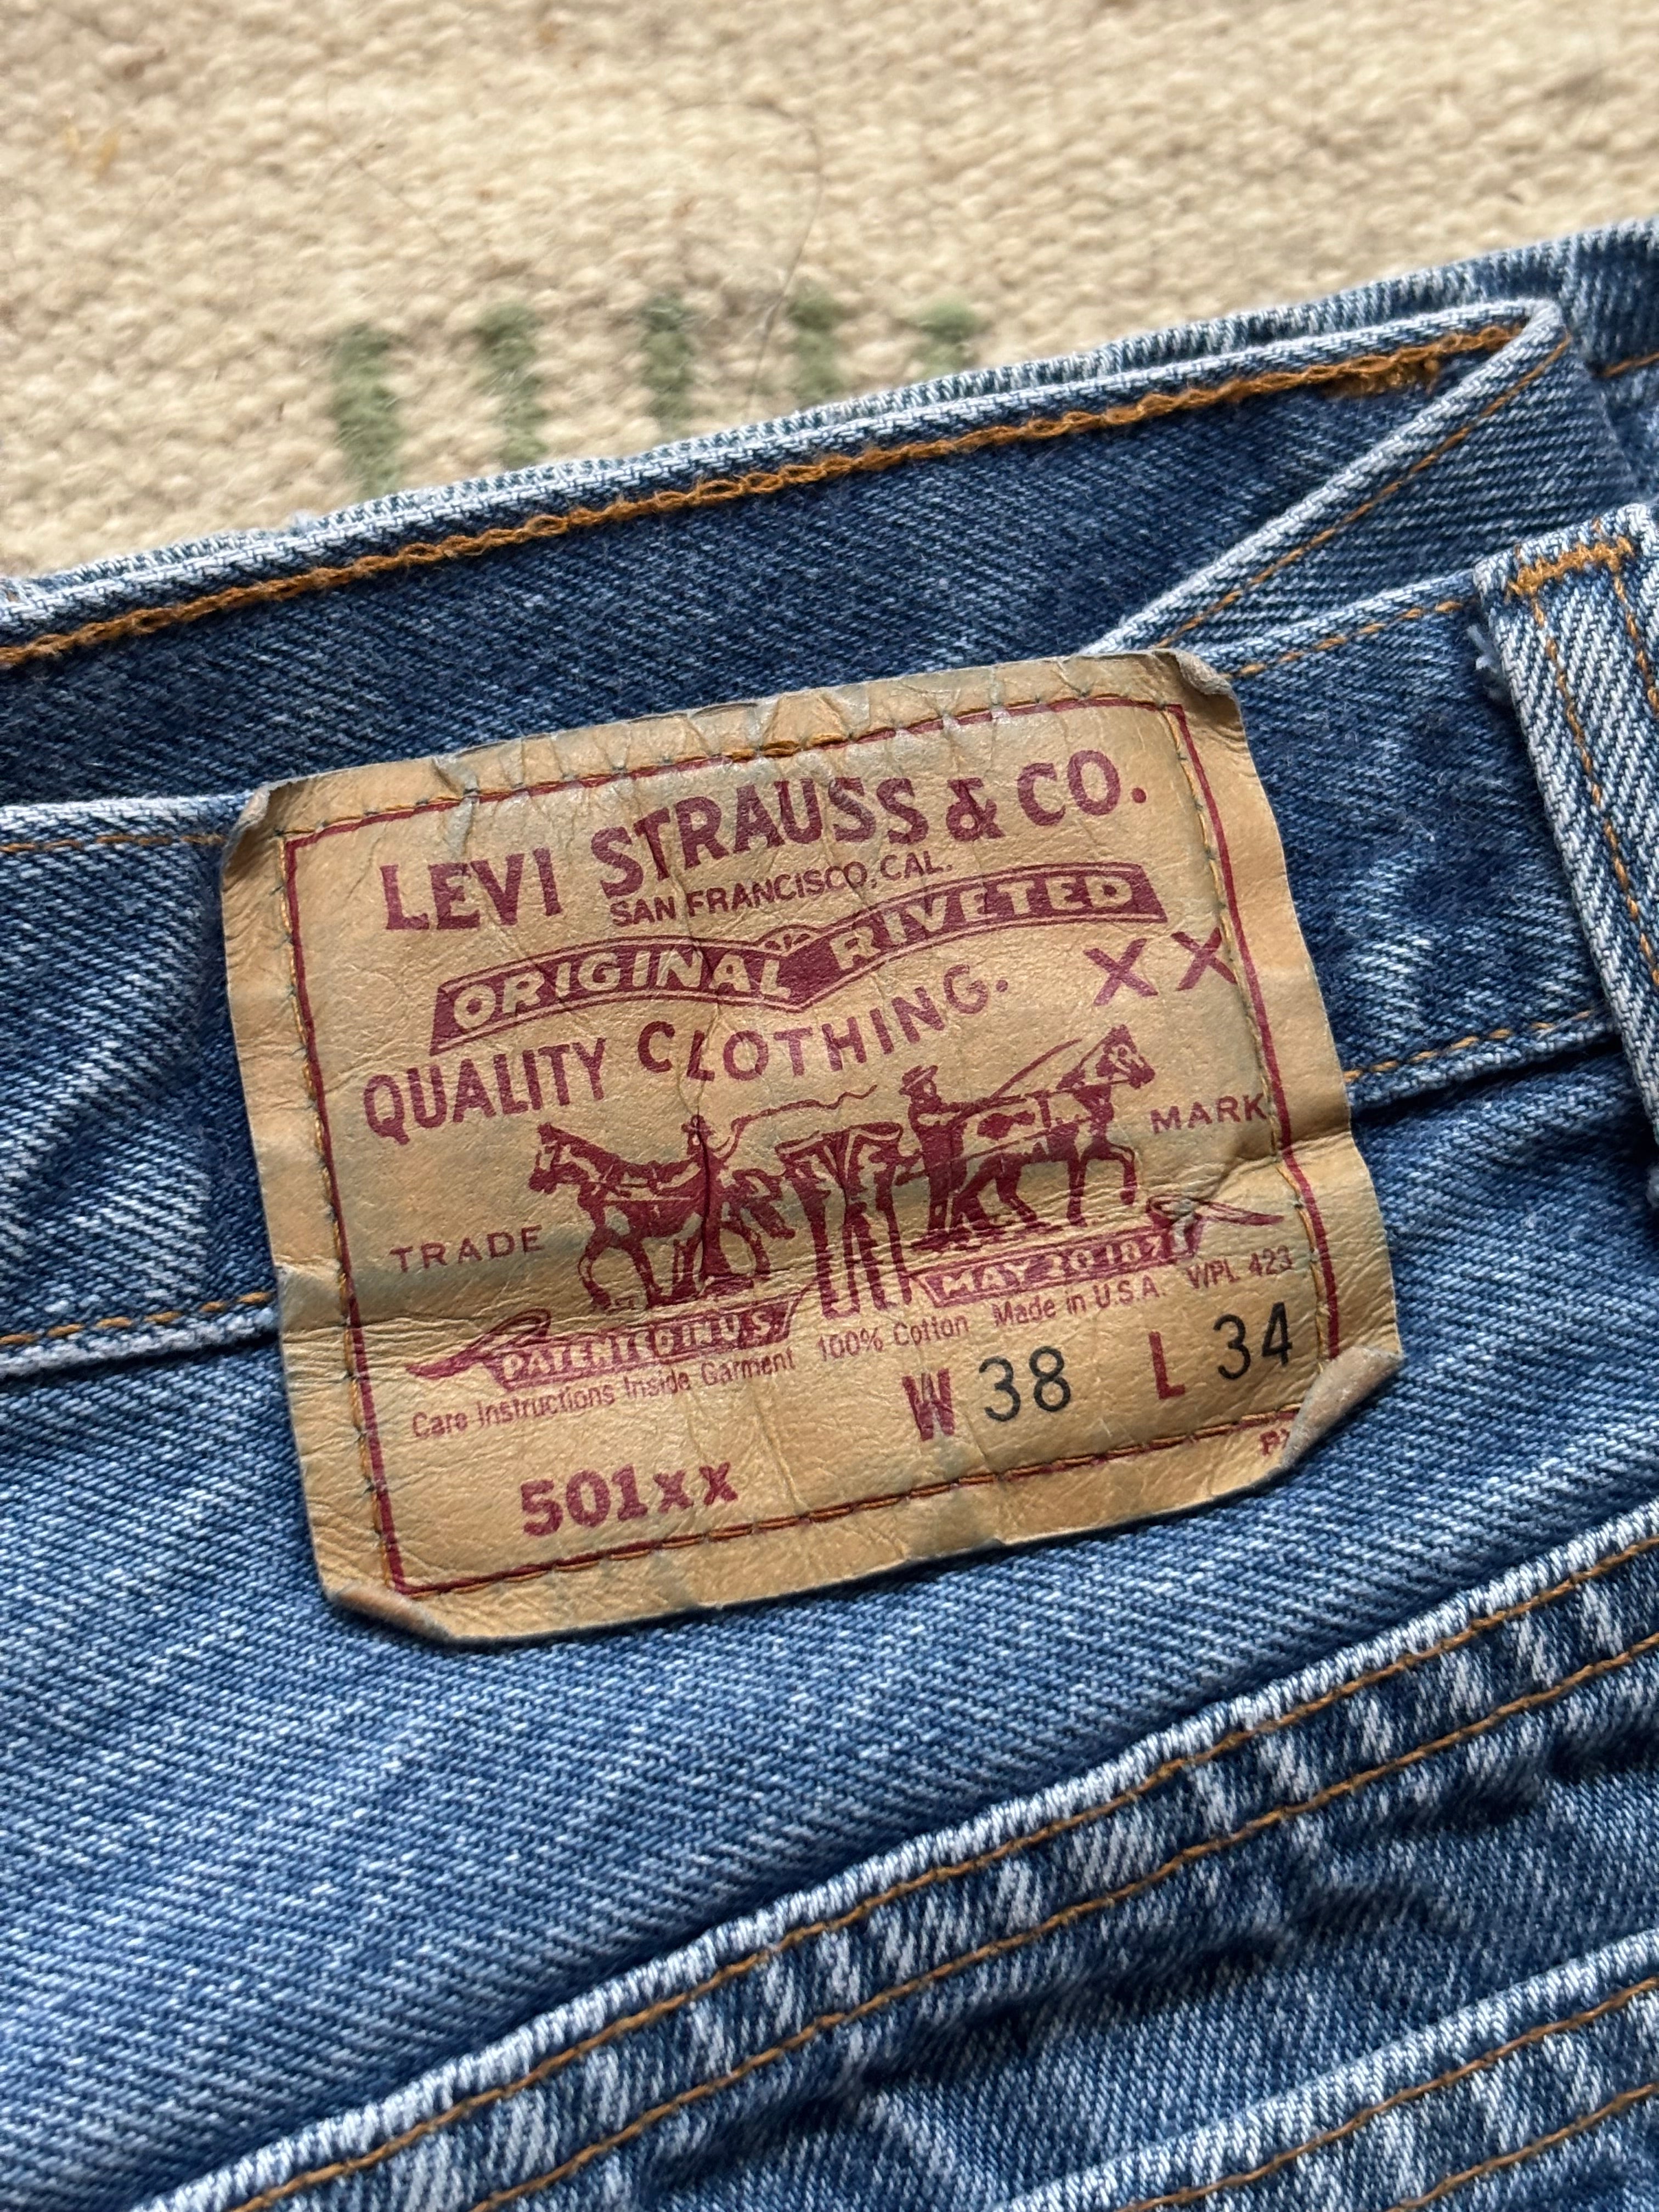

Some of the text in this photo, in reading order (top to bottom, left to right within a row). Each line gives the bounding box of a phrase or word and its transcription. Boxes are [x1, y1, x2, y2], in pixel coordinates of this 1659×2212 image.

[380, 749, 1147, 930] LEVI STRAUSS & CO.
[609, 850, 952, 927] SAN FRANCISCO, CAL.
[453, 876, 1134, 1029] ORIGINAL RIVETED
[363, 1037, 605, 1146] QUALITY
[1152, 1092, 1267, 1135] MARK
[390, 1224, 545, 1273] TRADE
[942, 1261, 1031, 1298] MAY
[1045, 1249, 1094, 1278] 20
[412, 1410, 469, 1438] Care
[476, 1380, 616, 1427] Instructions
[624, 1366, 692, 1399] Inside
[701, 1346, 796, 1386] Garment
[819, 1328, 884, 1362] 100%
[893, 1316, 969, 1346] Cotton
[991, 1296, 1057, 1328] Made
[1066, 1289, 1087, 1316] in
[1097, 1276, 1166, 1308] U.S.A.
[1249, 1244, 1293, 1277] 423
[500, 1326, 675, 1380] PATENTED
[901, 1302, 1293, 1442] W 38 L 34
